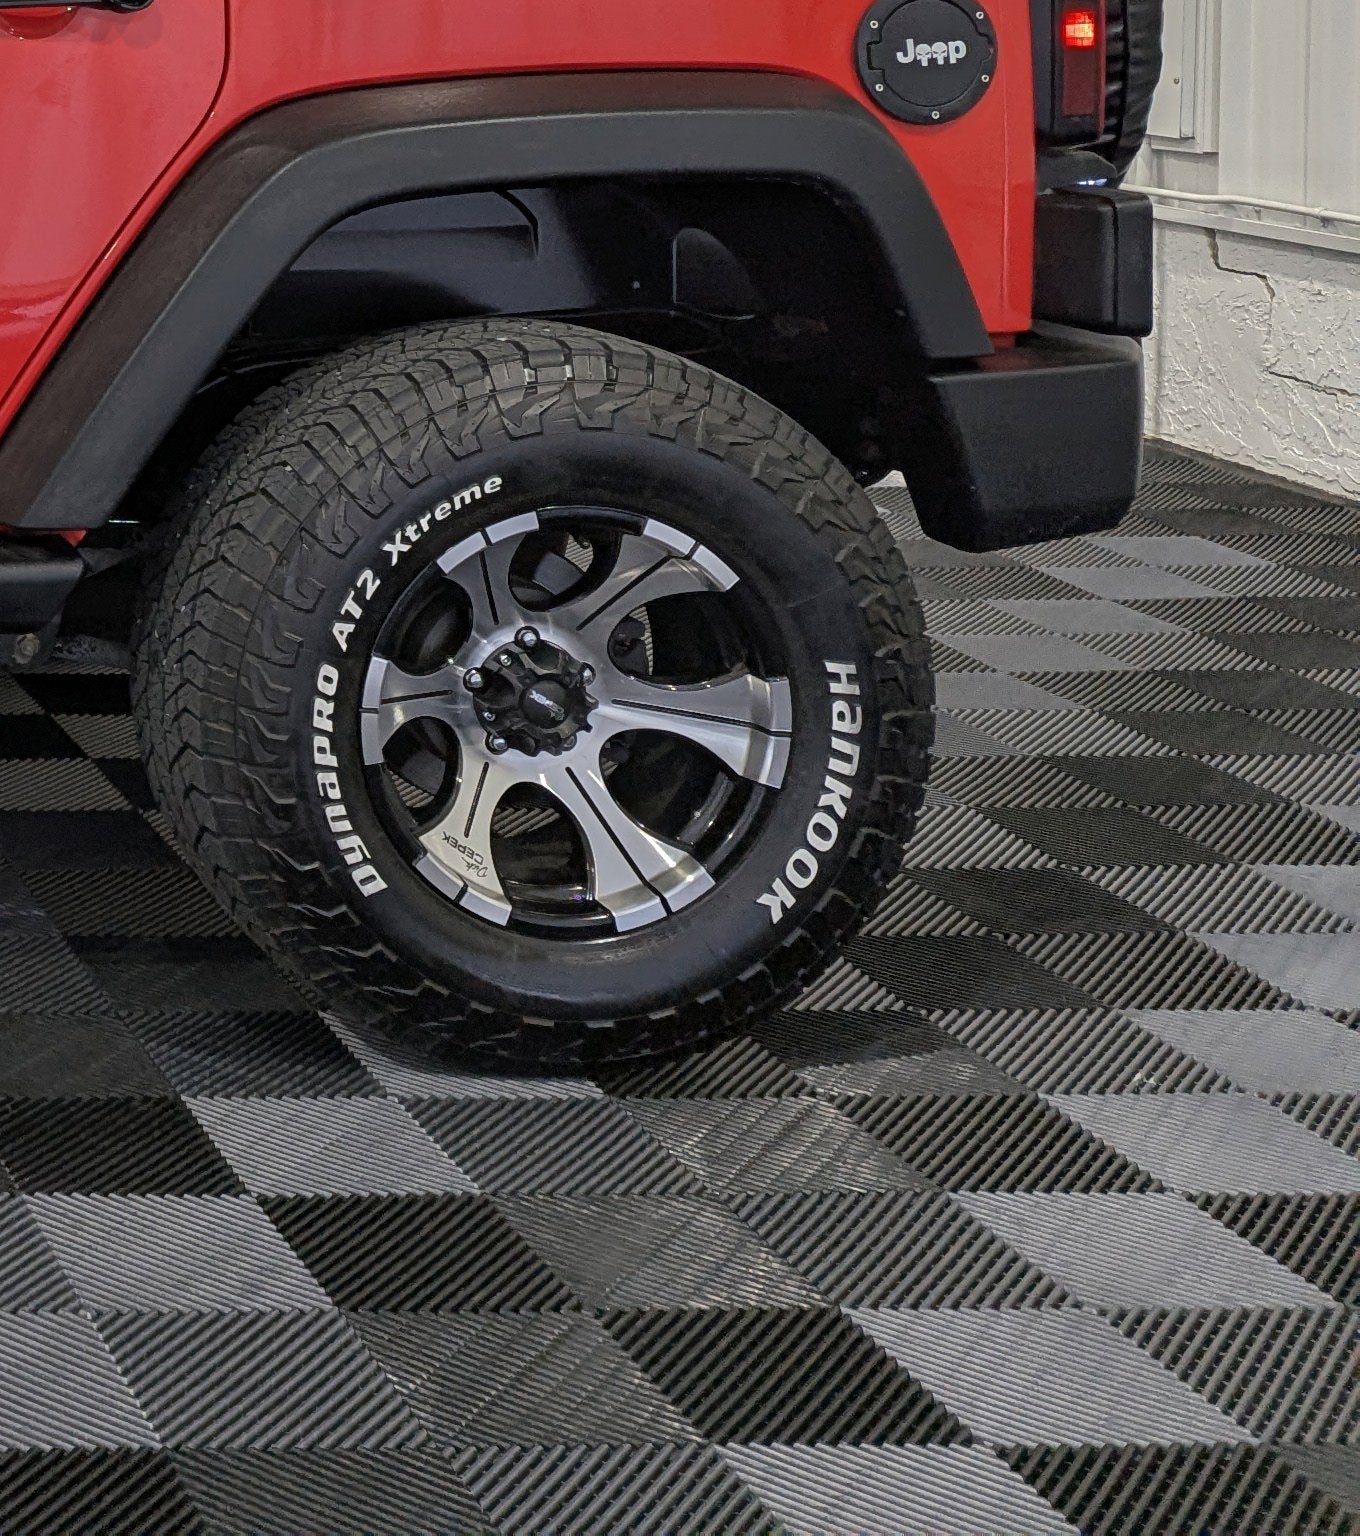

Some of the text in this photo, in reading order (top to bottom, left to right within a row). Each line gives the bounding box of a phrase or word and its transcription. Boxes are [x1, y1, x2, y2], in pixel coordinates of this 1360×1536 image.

[331, 569, 381, 652] AT2
[382, 476, 503, 566] Xtreme
[442, 831, 484, 866] CEPEK
